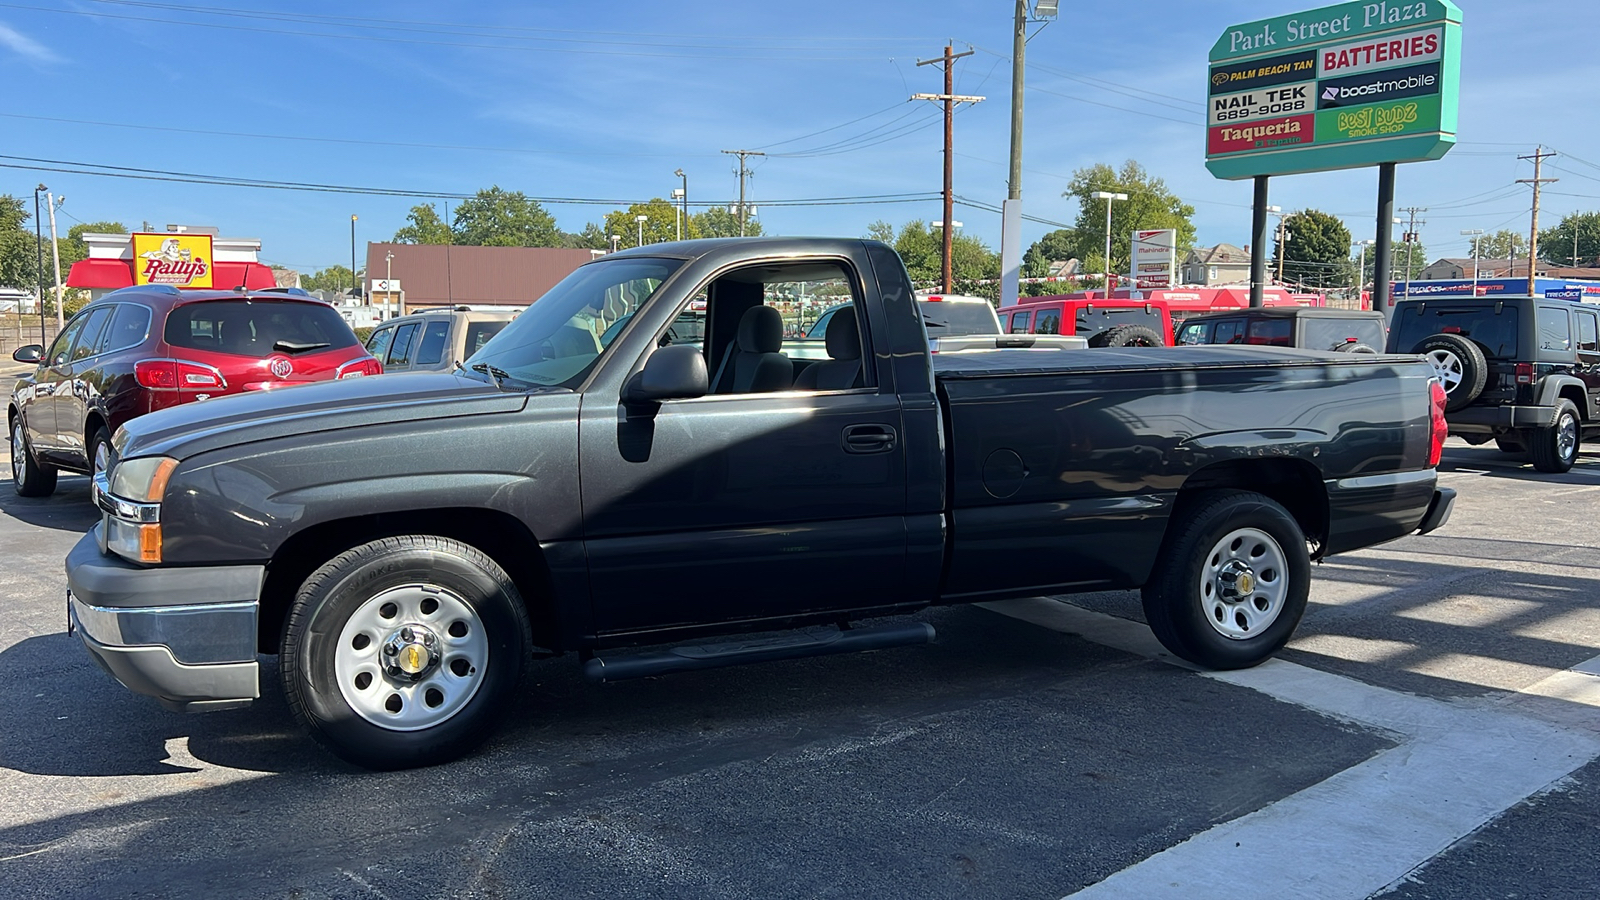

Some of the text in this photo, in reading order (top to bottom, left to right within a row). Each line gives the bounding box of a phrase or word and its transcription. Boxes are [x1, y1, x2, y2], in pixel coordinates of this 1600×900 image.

[1229, 1, 1428, 52] Park Street Plaza
[1324, 33, 1438, 71] BATTERIES
[1230, 60, 1314, 81] PALM BEACH TAN
[1215, 86, 1307, 111] NAIL TEK
[1217, 100, 1305, 121] 689-9088
[1348, 124, 1404, 138] SMOKE SHOP
[143, 257, 206, 283] Rally's
